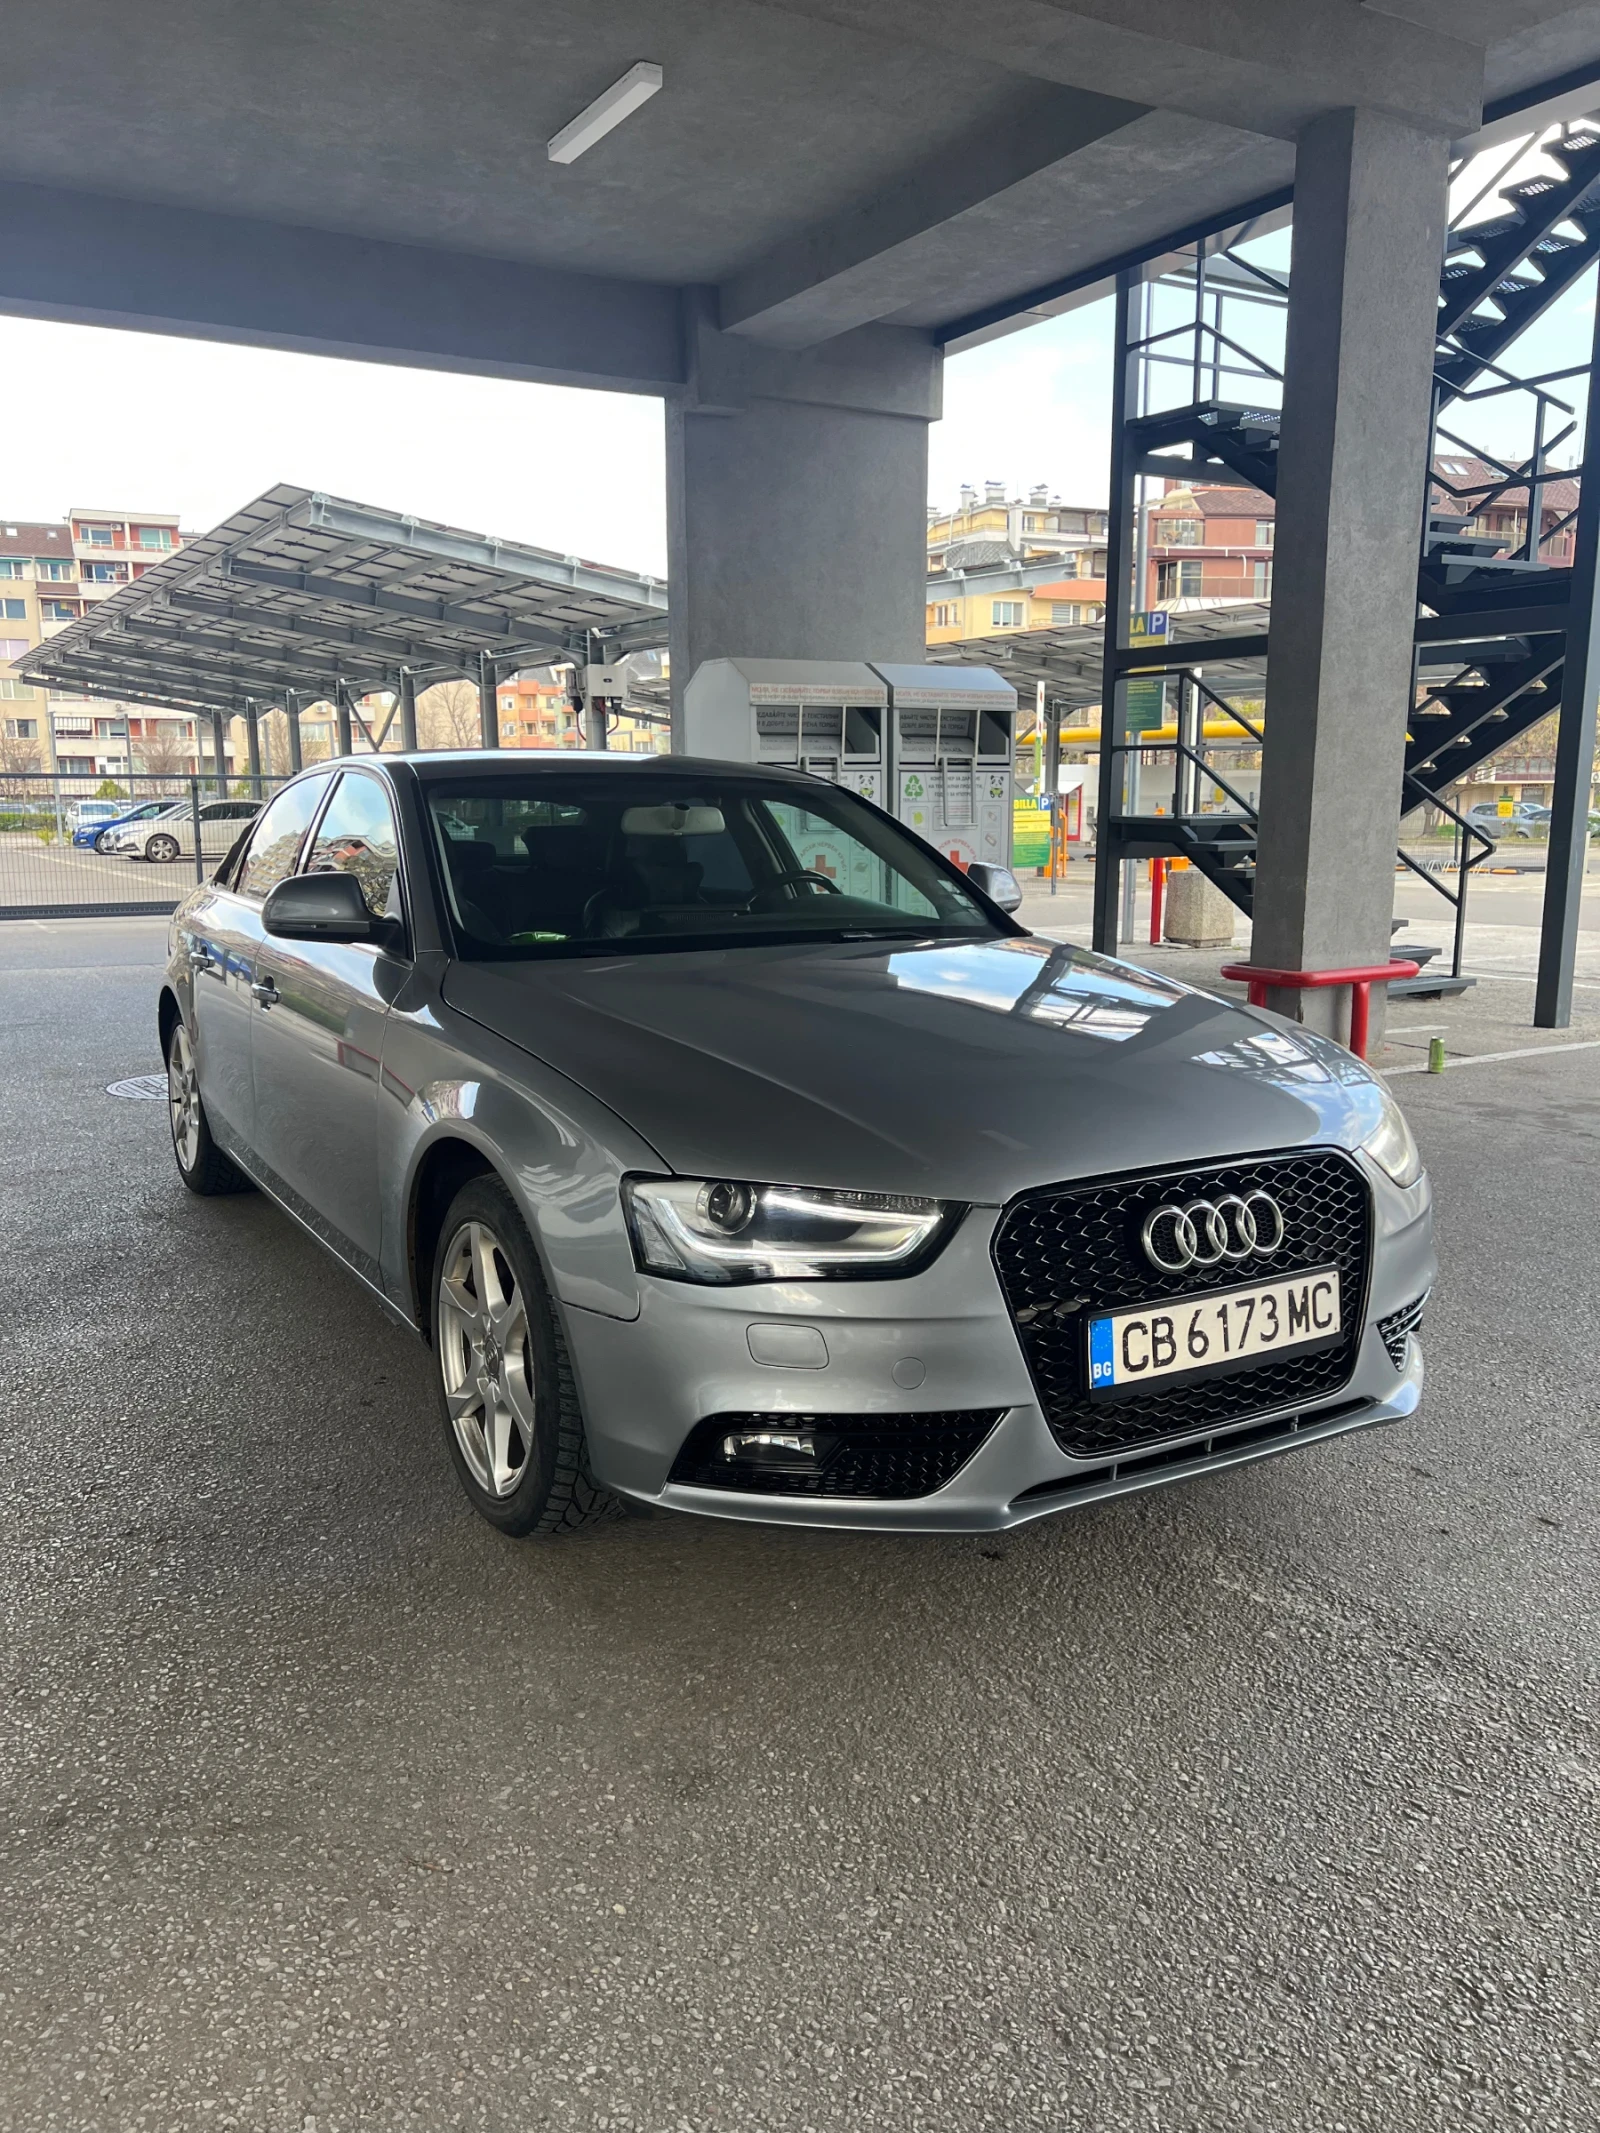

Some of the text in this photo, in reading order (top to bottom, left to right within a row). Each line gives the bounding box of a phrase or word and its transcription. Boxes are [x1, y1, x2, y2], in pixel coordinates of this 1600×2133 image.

[1151, 613, 1164, 633] P
[1013, 797, 1049, 810] BILLA P
[1121, 1281, 1333, 1373] CB 6173 MC
[1093, 1361, 1112, 1379] BG
